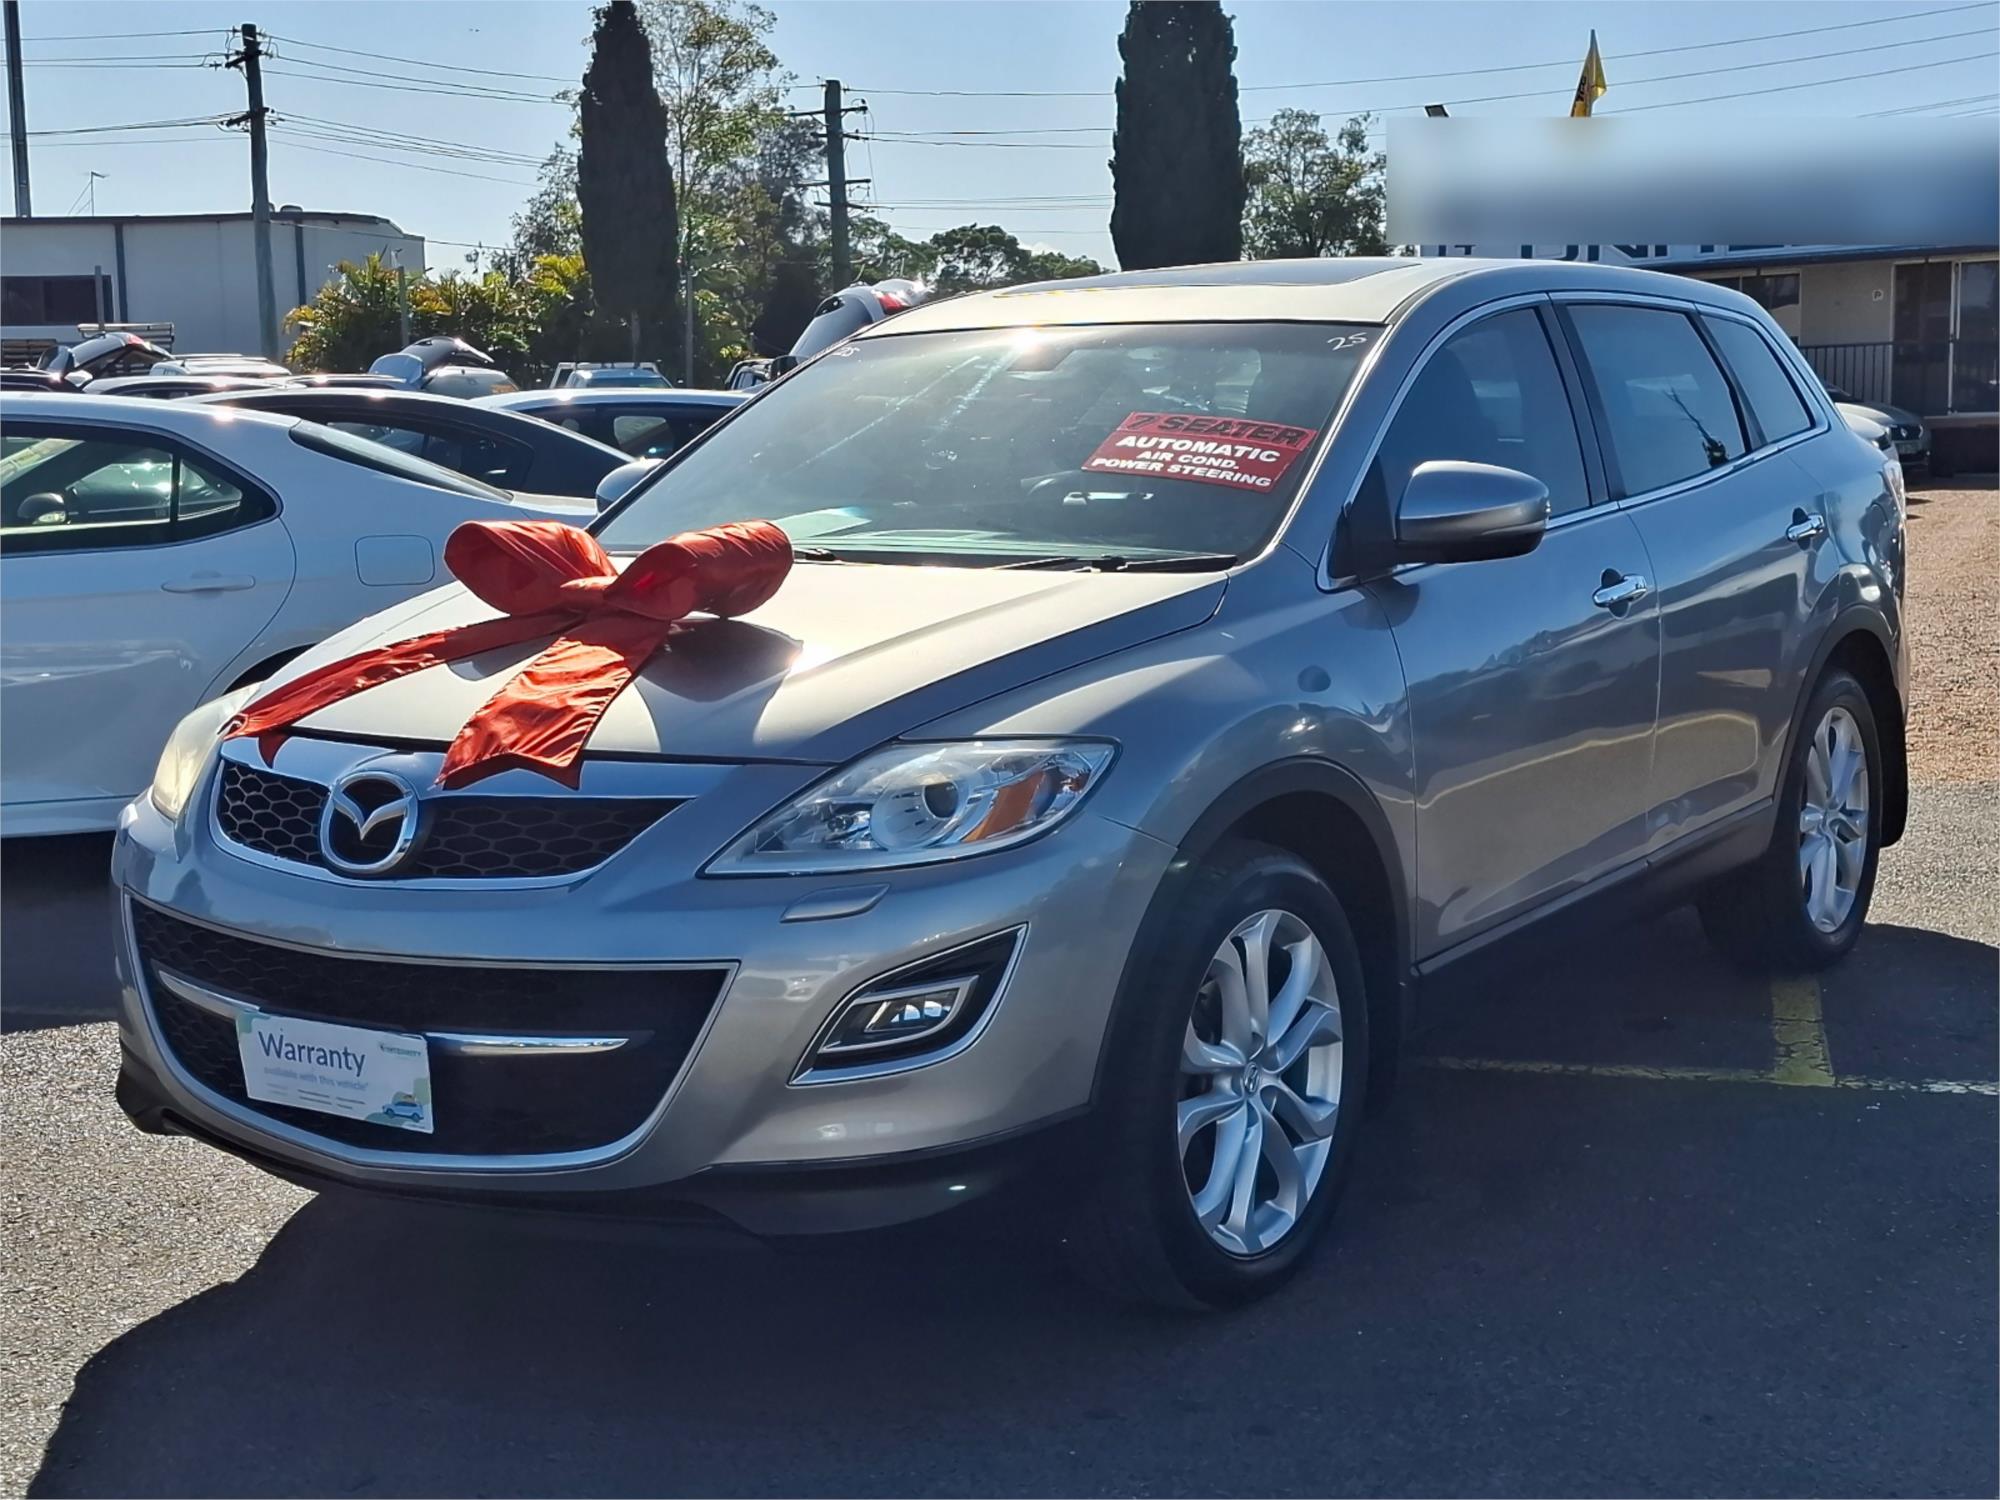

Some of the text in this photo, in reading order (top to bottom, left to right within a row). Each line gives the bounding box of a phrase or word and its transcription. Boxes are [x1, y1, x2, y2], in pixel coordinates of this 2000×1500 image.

[1129, 415, 1307, 448] 7 SEATER
[1116, 436, 1280, 463] AUTOMATIC
[1136, 451, 1239, 470] AIR COND.
[1091, 458, 1271, 487] POWER STEERING
[258, 1031, 366, 1077] Warranty
